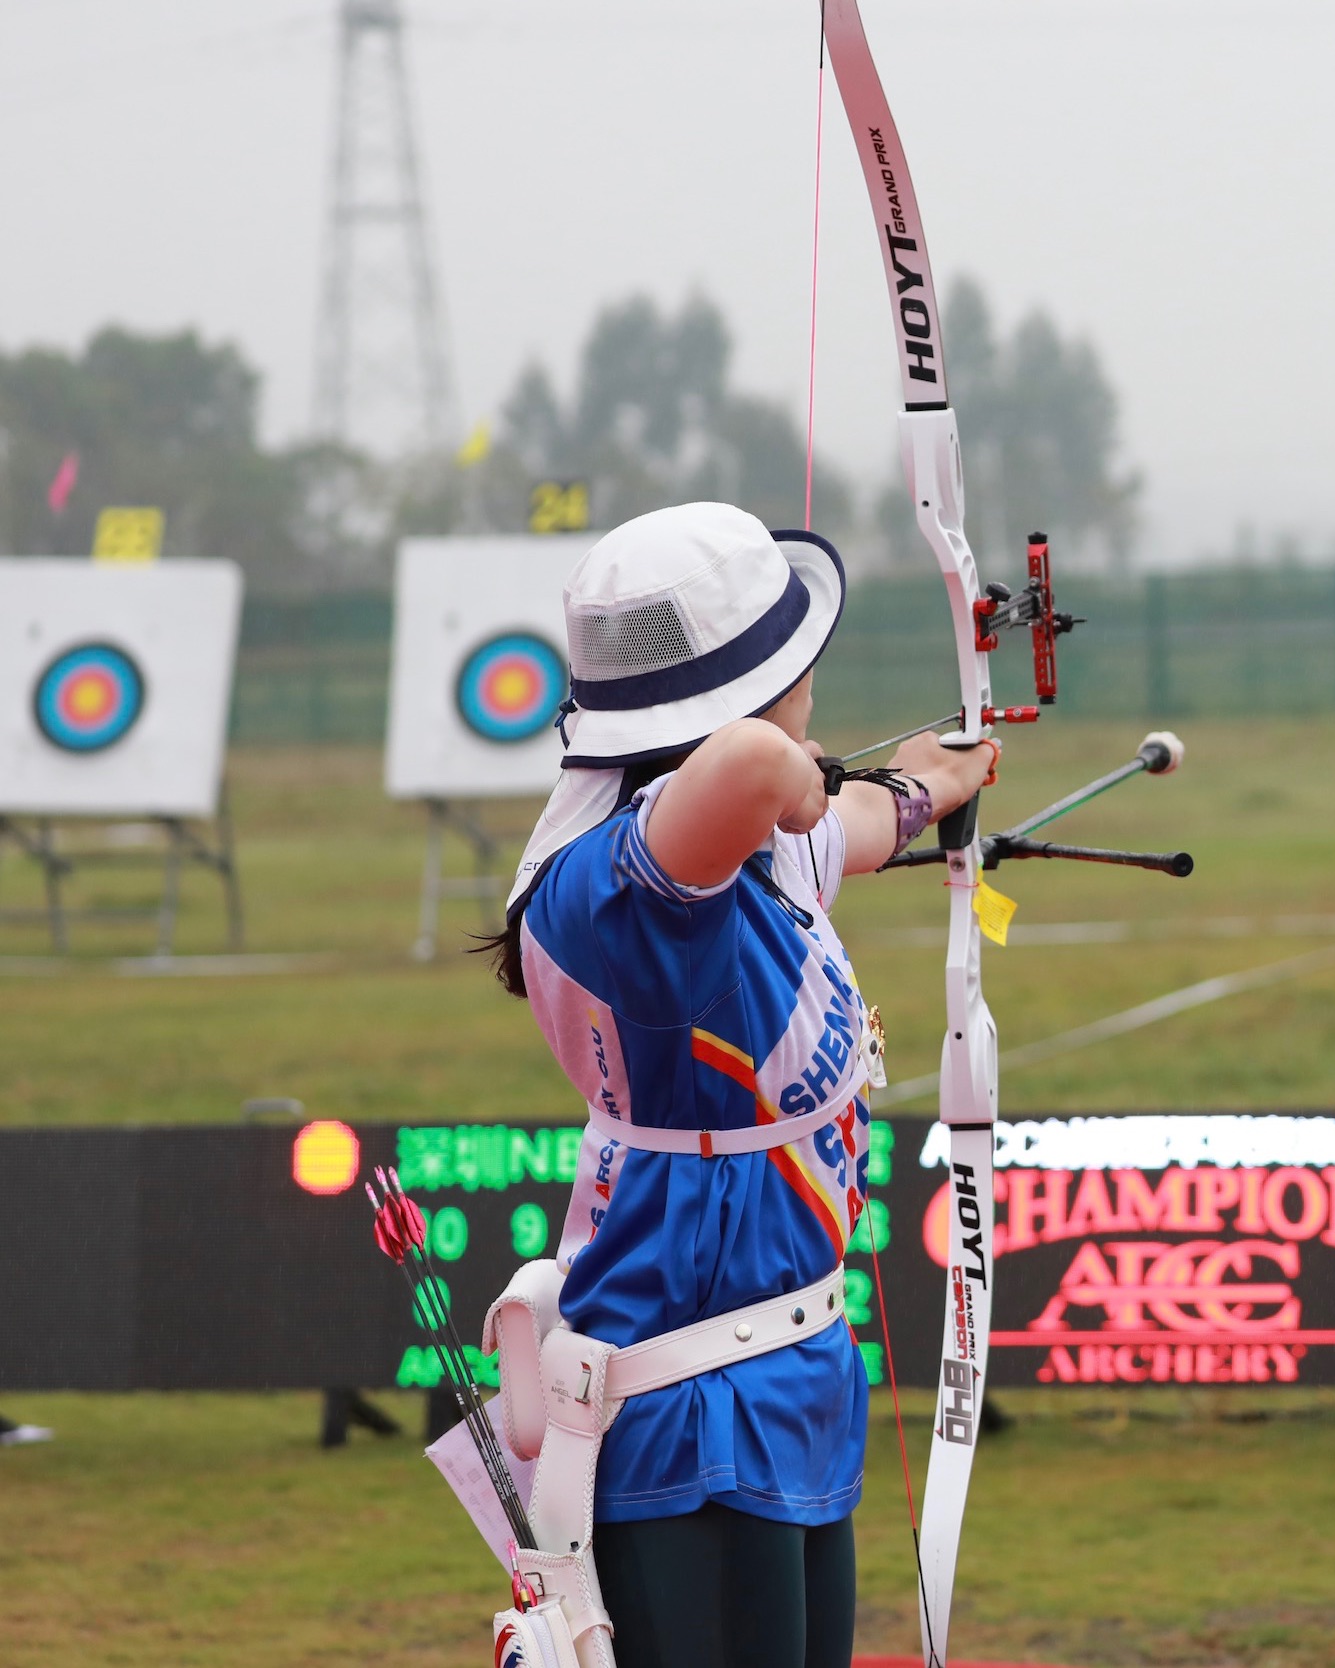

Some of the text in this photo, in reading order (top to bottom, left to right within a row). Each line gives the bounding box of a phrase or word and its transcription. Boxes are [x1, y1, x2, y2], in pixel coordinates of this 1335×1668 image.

[867, 126, 938, 384] HOYT GRAND PRIX
[512, 1203, 548, 1258] 9
[952, 1162, 987, 1290] HOYT
[964, 1283, 977, 1361] GRAND PRIX
[1037, 1344, 1306, 1383] ARCHERY
[942, 1357, 974, 1447] 840
